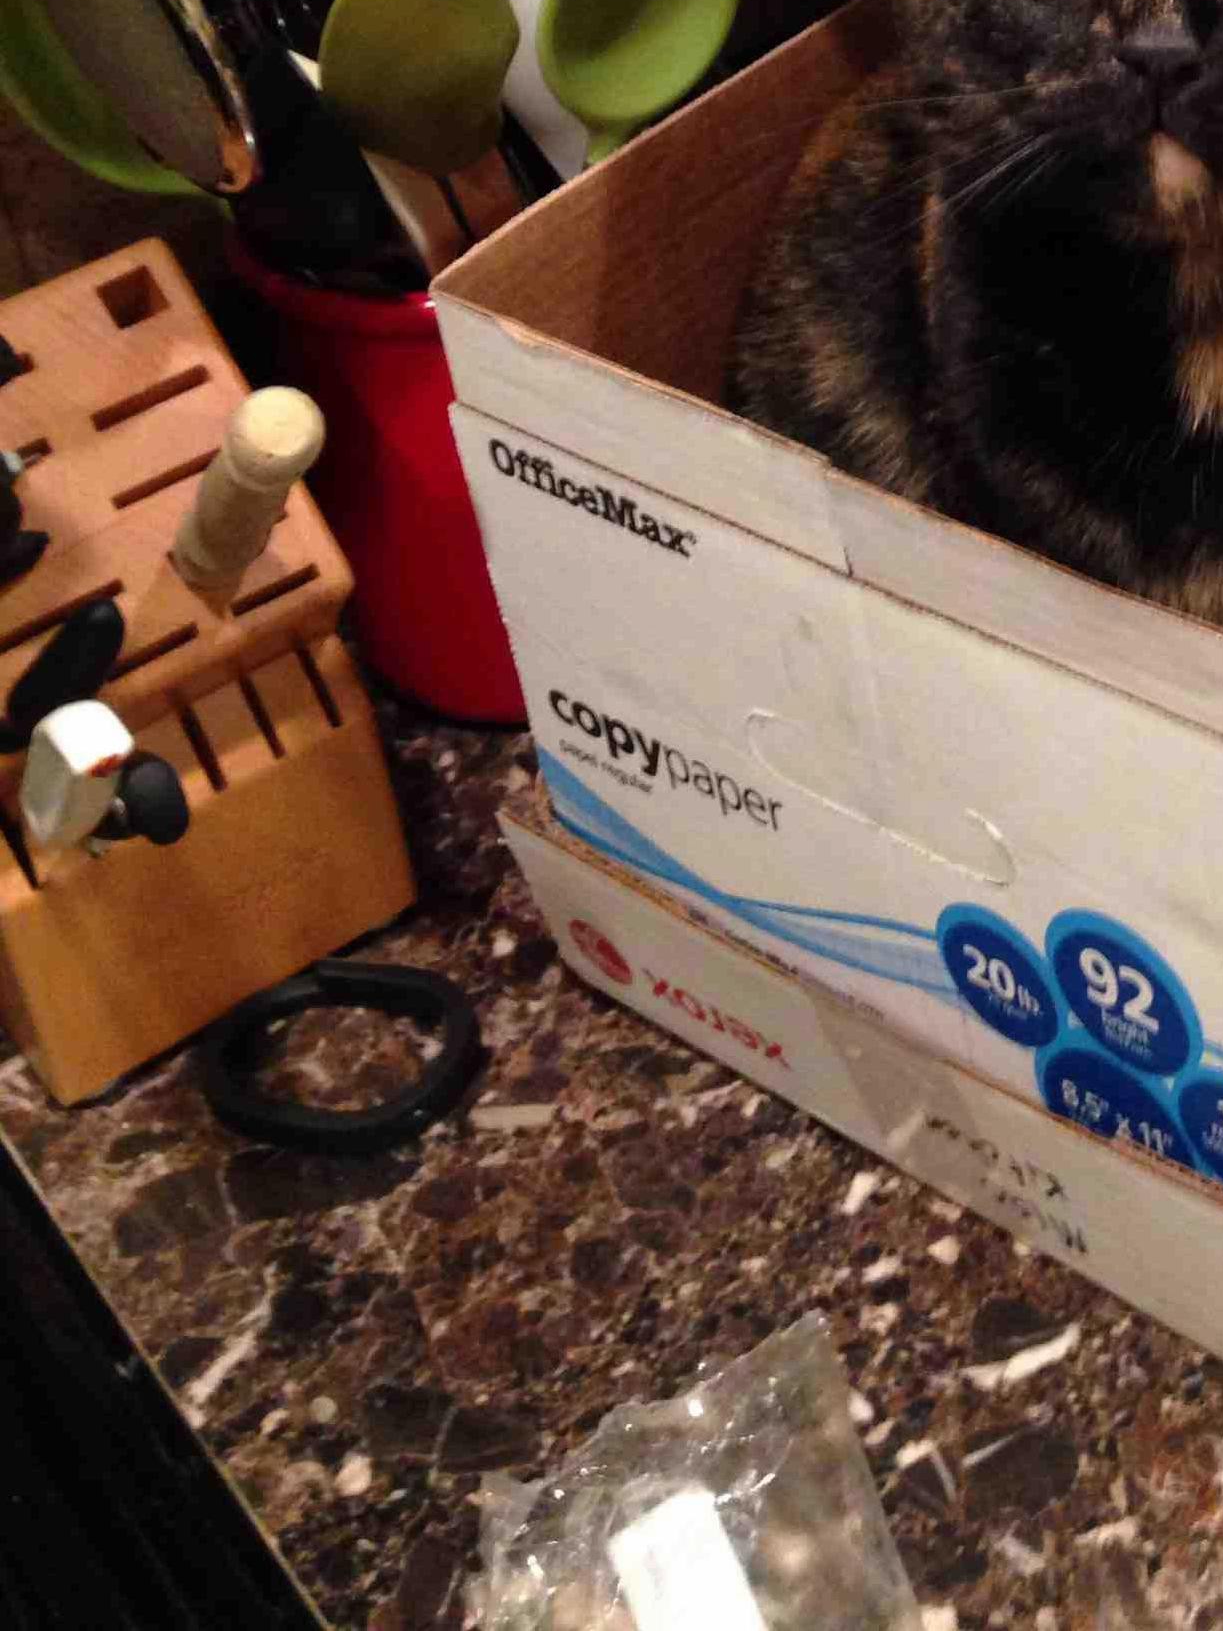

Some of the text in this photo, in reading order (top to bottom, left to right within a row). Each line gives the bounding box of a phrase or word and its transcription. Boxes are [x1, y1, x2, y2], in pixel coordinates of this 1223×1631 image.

[488, 439, 693, 558] OfficeMax
[963, 943, 1016, 1003] 20
[1079, 947, 1160, 1035] 92
